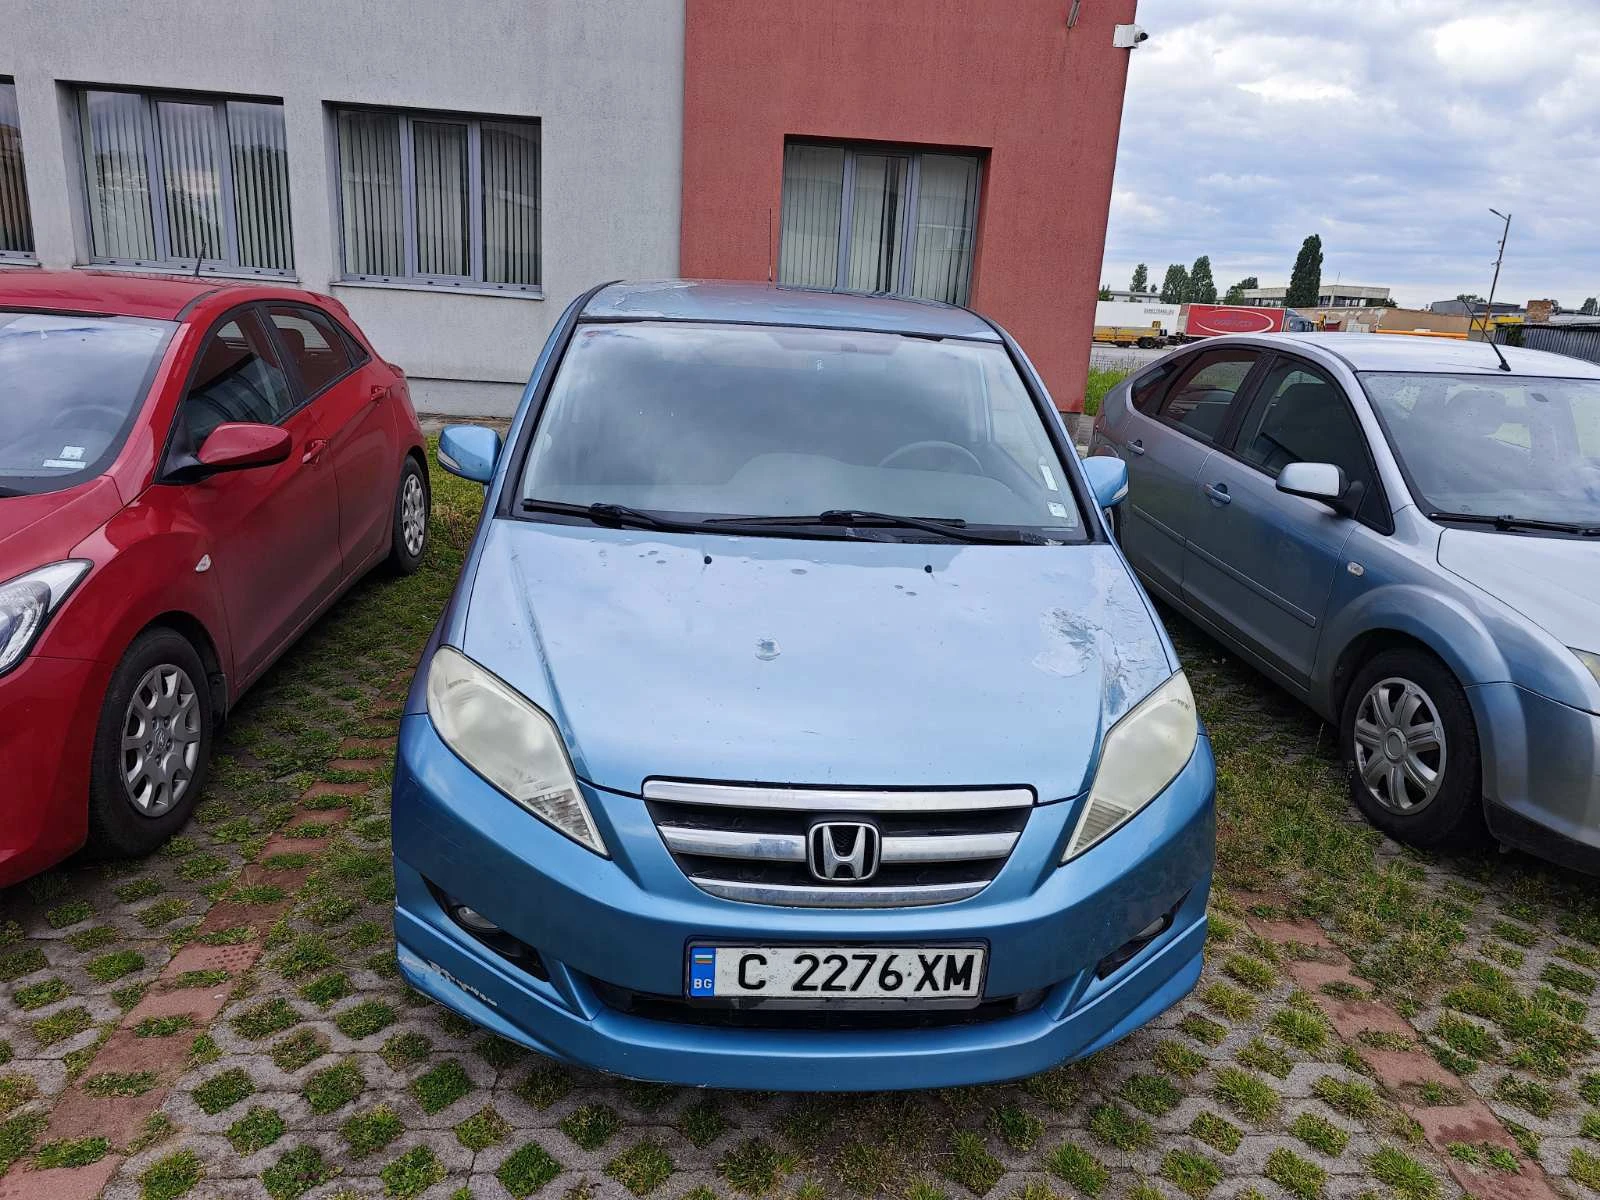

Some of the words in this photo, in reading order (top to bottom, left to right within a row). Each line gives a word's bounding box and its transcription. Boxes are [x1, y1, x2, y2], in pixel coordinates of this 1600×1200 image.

[693, 978, 713, 989] BG
[738, 953, 768, 991] C
[792, 953, 904, 992] 2276
[913, 953, 975, 992] XM
